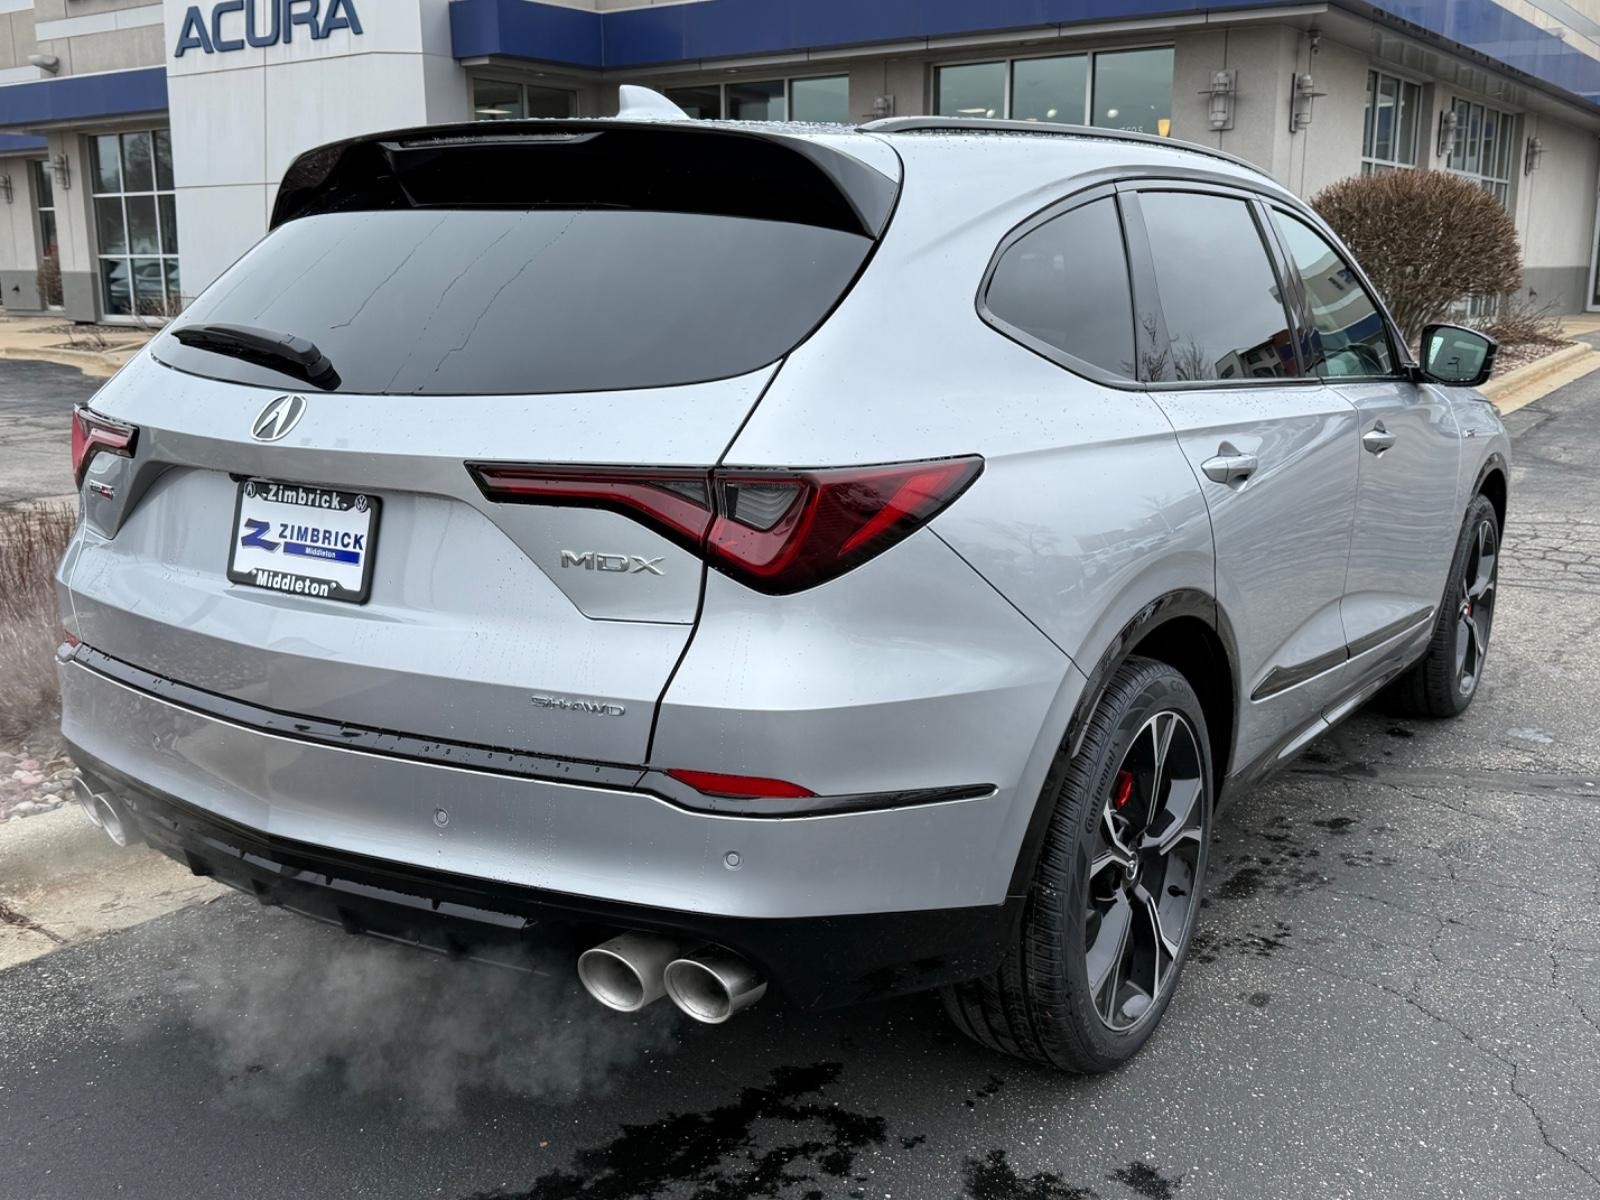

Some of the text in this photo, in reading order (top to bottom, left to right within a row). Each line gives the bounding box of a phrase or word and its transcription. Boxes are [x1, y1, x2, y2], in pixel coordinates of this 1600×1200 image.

[174, 0, 363, 57] ACURA
[266, 484, 341, 509] Zimbrick
[278, 523, 364, 550] ZIMBRICK
[305, 547, 336, 559] Middleton
[560, 549, 666, 576] MDX
[256, 570, 329, 597] Middleton
[1085, 749, 1116, 834] Continental
